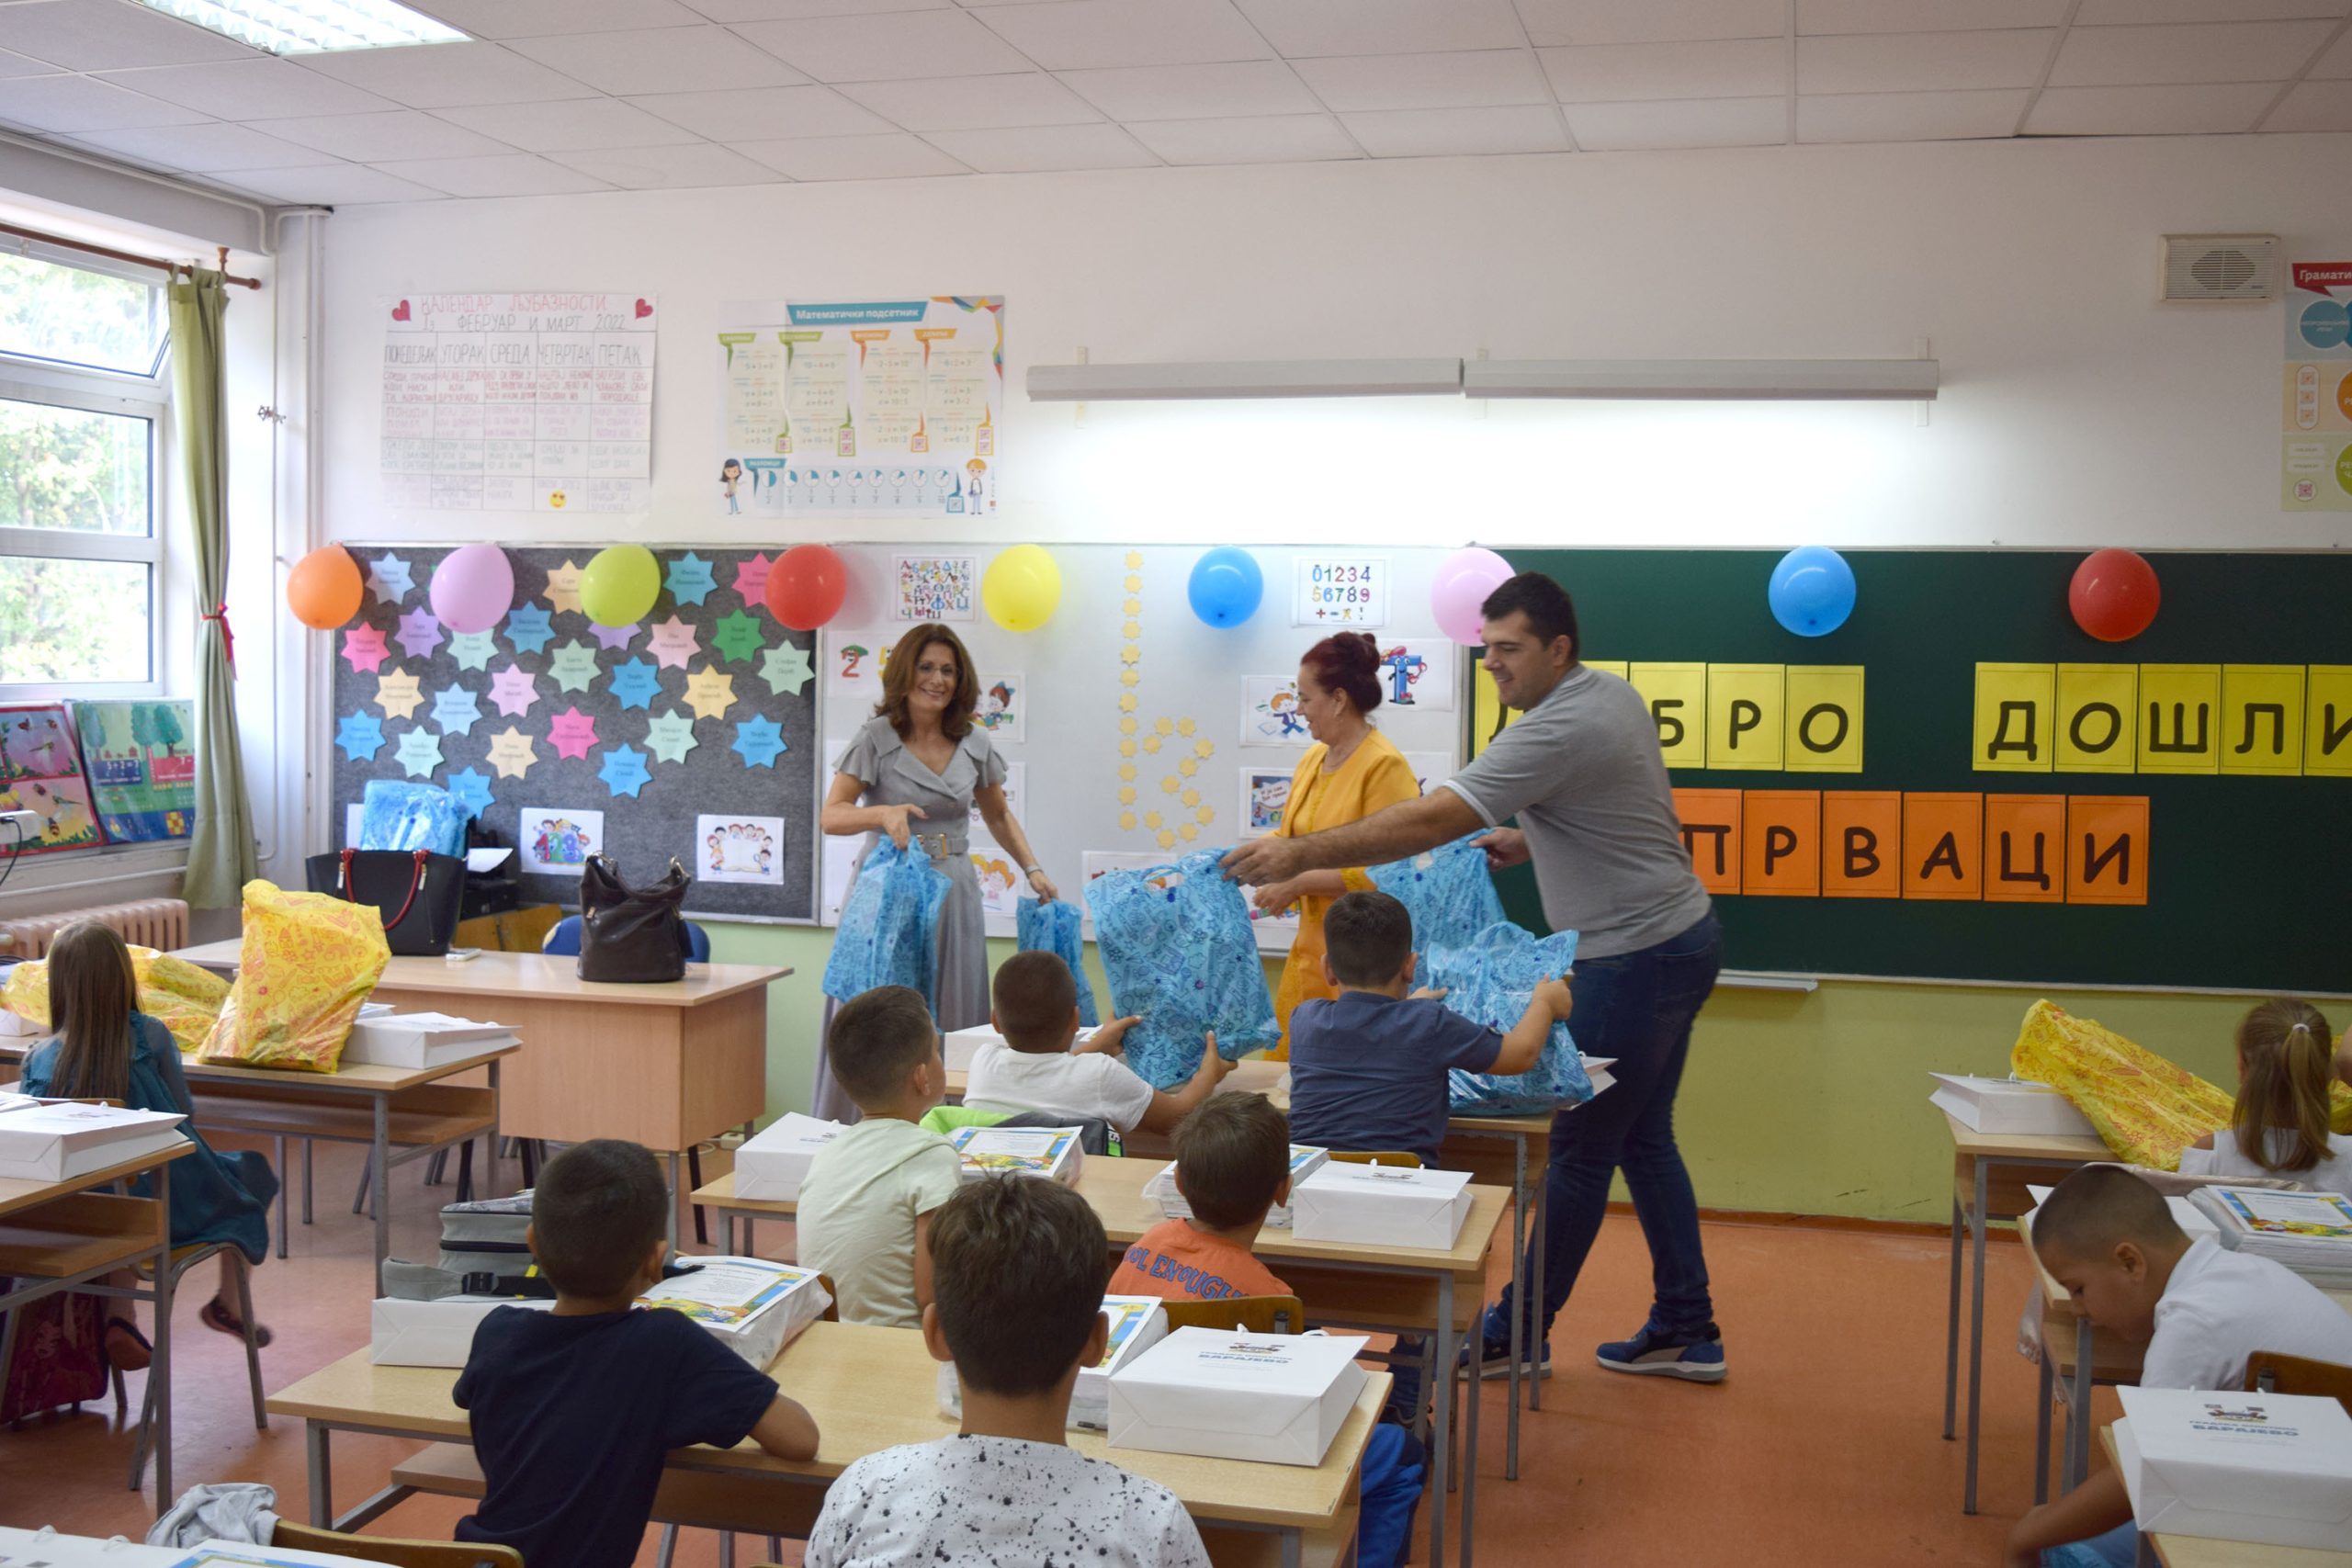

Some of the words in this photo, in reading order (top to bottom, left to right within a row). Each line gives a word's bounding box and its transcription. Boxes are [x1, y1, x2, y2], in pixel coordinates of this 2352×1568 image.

[547, 315, 583, 332] МАРТ
[594, 313, 627, 331] 2022
[796, 309, 865, 321] Математички
[866, 308, 920, 320] подсетник
[491, 344, 530, 366] СРЕДА
[598, 344, 642, 366] ПЕТАК
[1488, 700, 1849, 753] БРО
[1988, 700, 2352, 761] ДОШЛИ
[1680, 824, 2131, 891] ПРВАЦИ
[2192, 1425, 2300, 1436] БАРАЈЕВО
